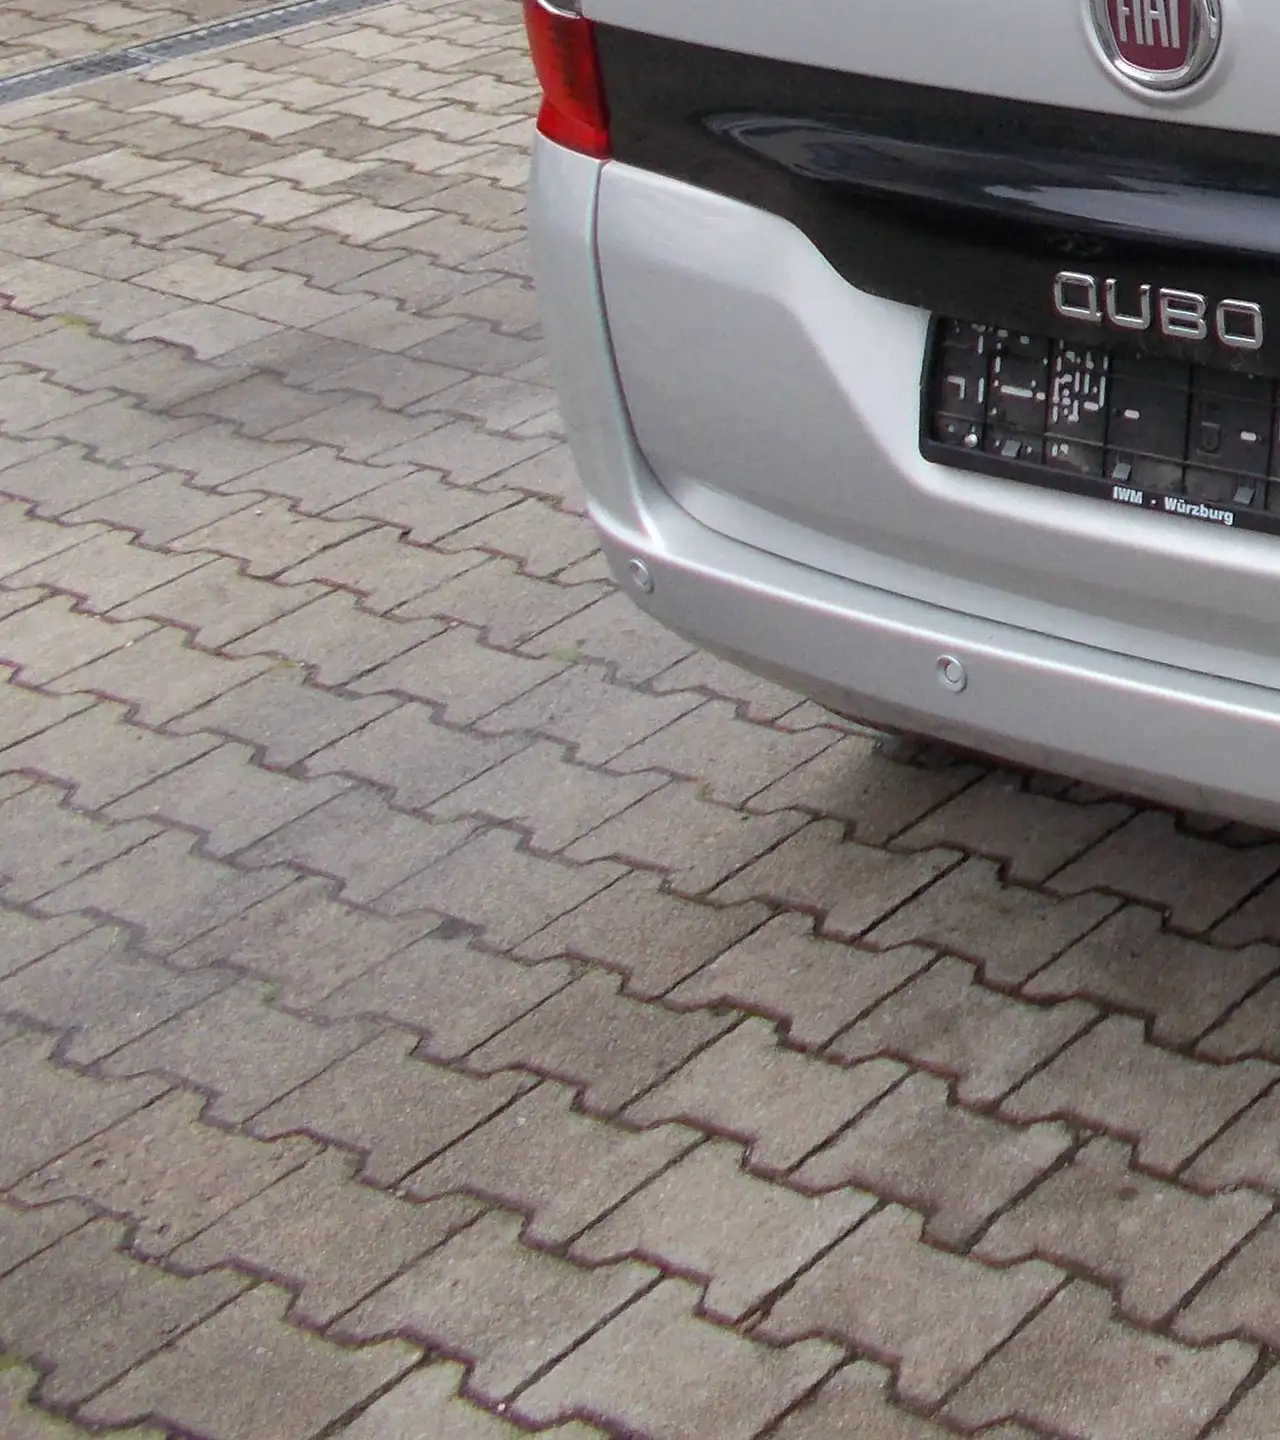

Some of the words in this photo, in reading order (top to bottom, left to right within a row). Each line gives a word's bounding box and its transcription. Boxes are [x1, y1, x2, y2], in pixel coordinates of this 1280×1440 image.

[1055, 271, 1263, 350] QUBO
[1112, 486, 1144, 505] IWM
[1164, 497, 1233, 526] Würzburg
